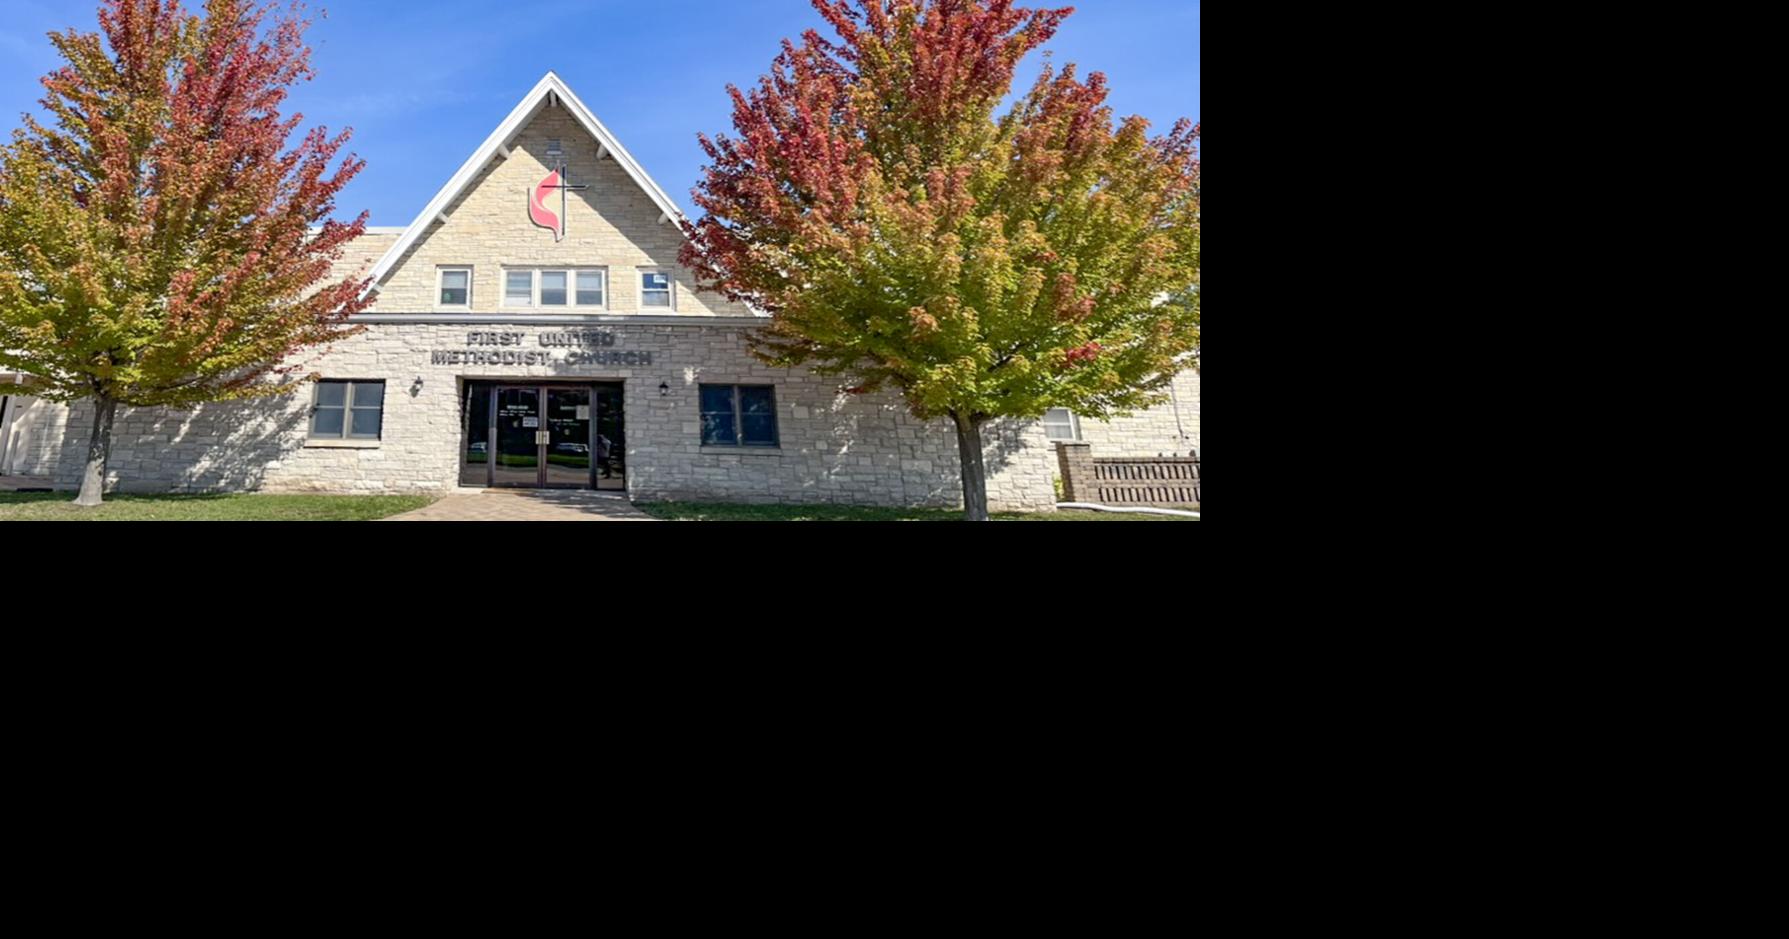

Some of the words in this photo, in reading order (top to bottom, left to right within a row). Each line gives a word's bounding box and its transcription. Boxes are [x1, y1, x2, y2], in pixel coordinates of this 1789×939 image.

[467, 331, 525, 346] FIRST
[539, 331, 615, 347] UNITED
[431, 351, 550, 366] METHODIST
[564, 351, 652, 366] CHURCH
